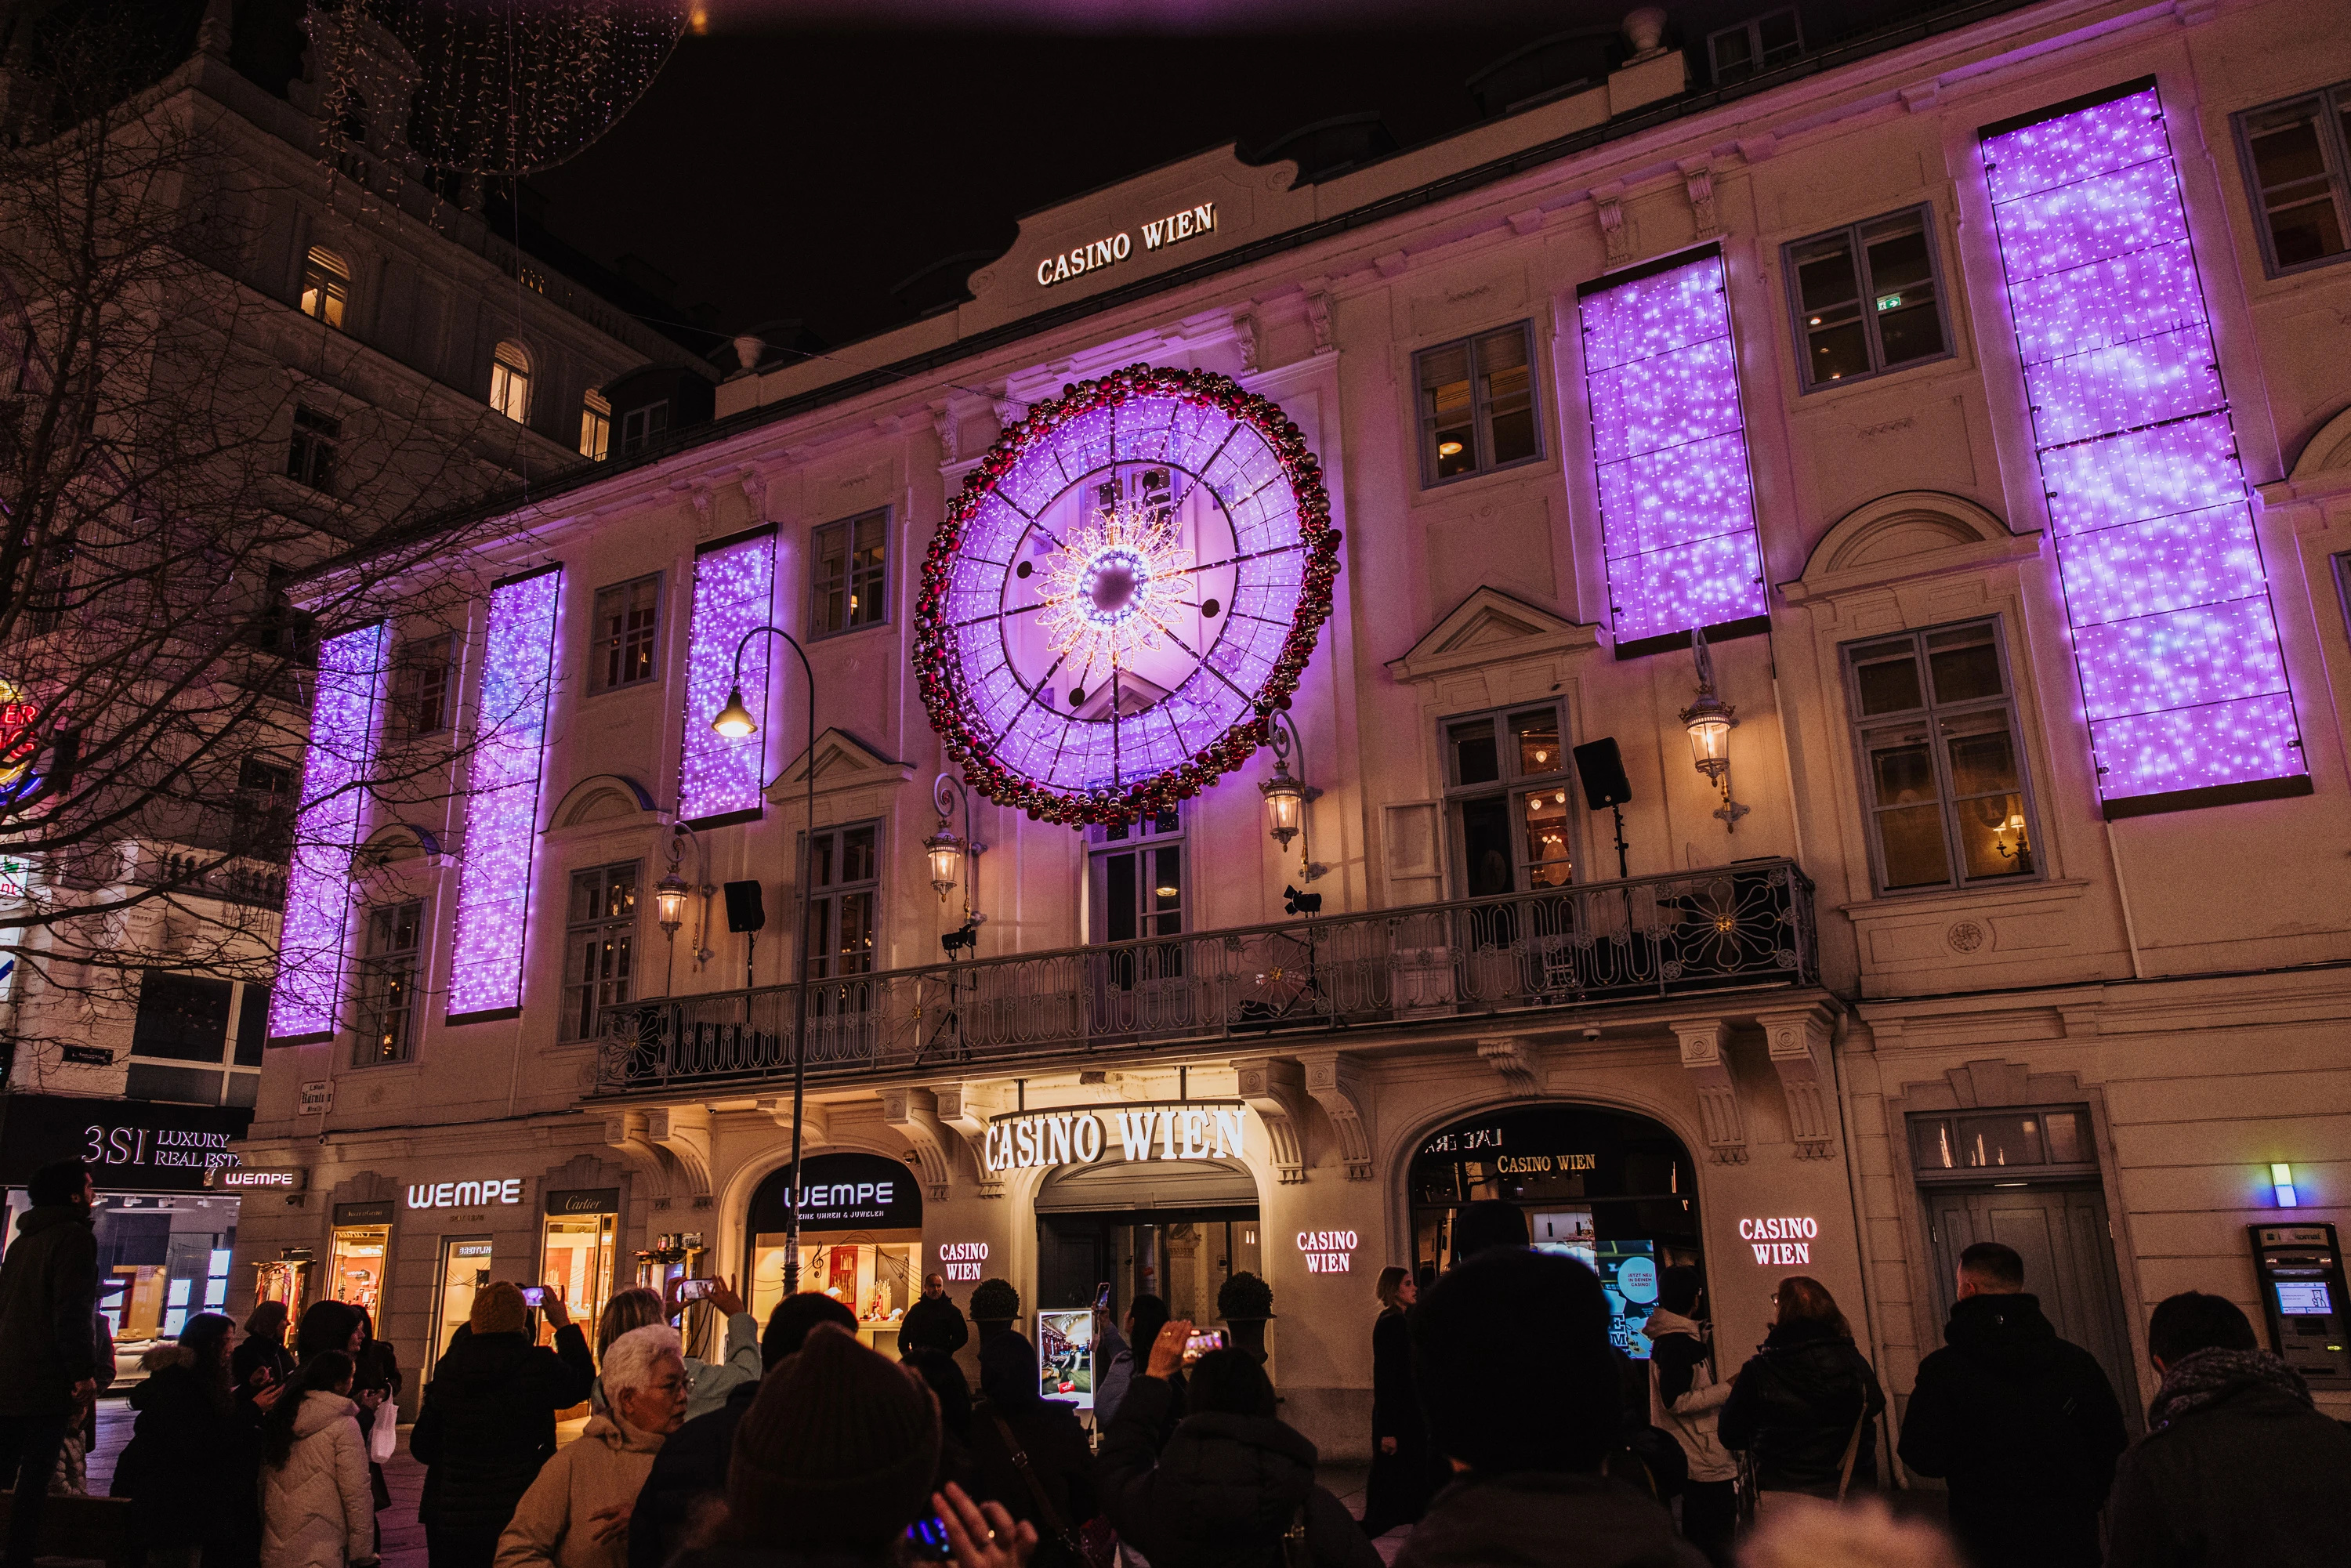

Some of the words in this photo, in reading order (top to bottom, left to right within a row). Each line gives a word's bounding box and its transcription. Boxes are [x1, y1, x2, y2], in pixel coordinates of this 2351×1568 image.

[1038, 233, 1131, 285] CASINO
[1142, 203, 1213, 249] WIEN
[82, 1125, 150, 1164] 3SI
[158, 1130, 232, 1149] LUXURY
[985, 1114, 1104, 1172] CASINO
[1115, 1110, 1246, 1161] WIEN
[154, 1150, 202, 1167] REAL
[1497, 1155, 1552, 1173] CASINO
[1556, 1154, 1596, 1170] WIEN
[225, 1173, 293, 1185] WEMPE
[408, 1179, 522, 1208] WEMPE
[565, 1196, 602, 1211] Cartier
[784, 1182, 893, 1208] WEMPE
[1739, 1217, 1817, 1240] CASINO
[458, 1246, 492, 1255] BREITLIN
[1297, 1230, 1358, 1251] CASINO
[940, 1242, 989, 1261] CASINO
[1751, 1243, 1809, 1265] WIEN
[946, 1262, 981, 1280] WIEN
[1305, 1253, 1349, 1273] WIEN
